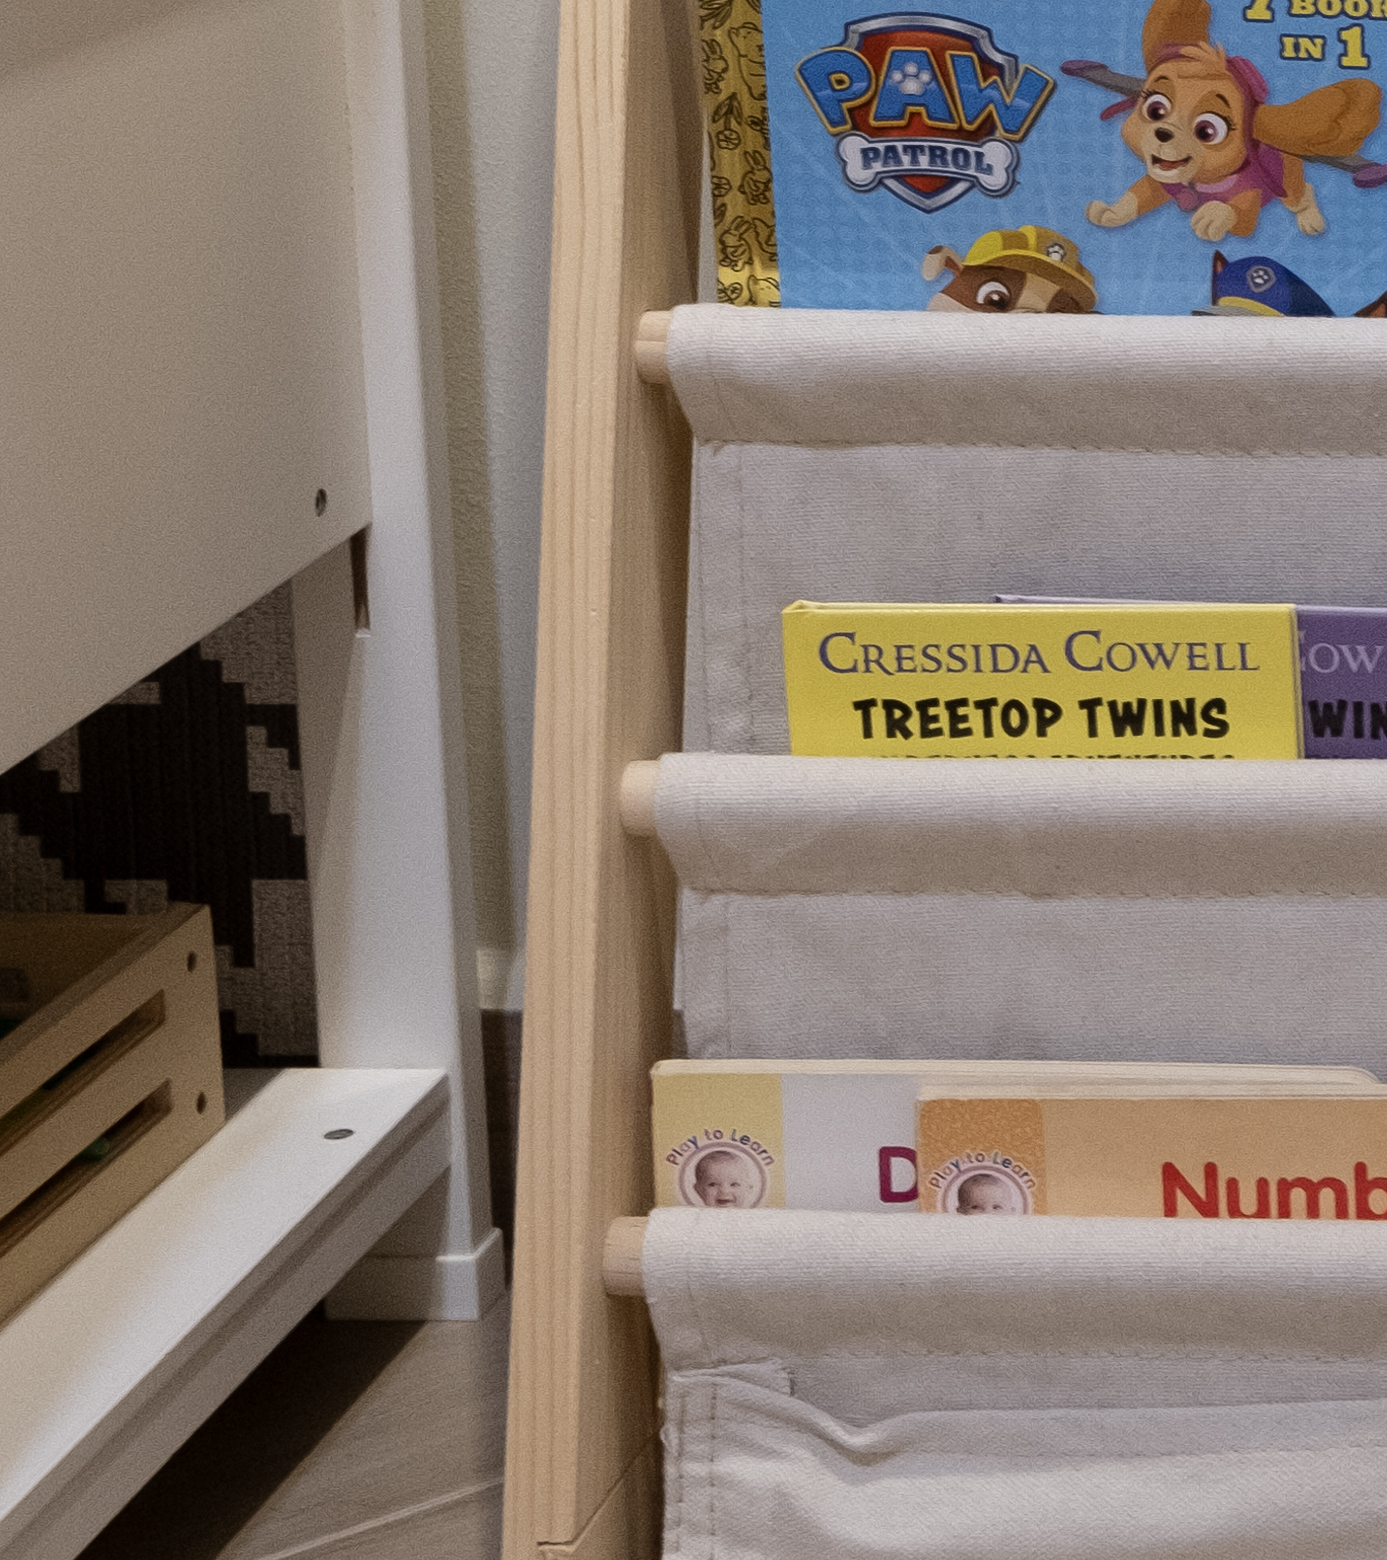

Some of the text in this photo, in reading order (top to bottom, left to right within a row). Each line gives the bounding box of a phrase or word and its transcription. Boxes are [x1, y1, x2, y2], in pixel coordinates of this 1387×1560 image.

[1281, 26, 1371, 69] IN 1
[796, 46, 1058, 140] PAW
[859, 141, 994, 177] PATROL
[818, 629, 1261, 675] CRESSIDA COWELL
[852, 697, 1231, 740] TREETOP TWINS
[666, 1129, 775, 1168] Play to Learn
[929, 1151, 1036, 1192] Play to Learn
